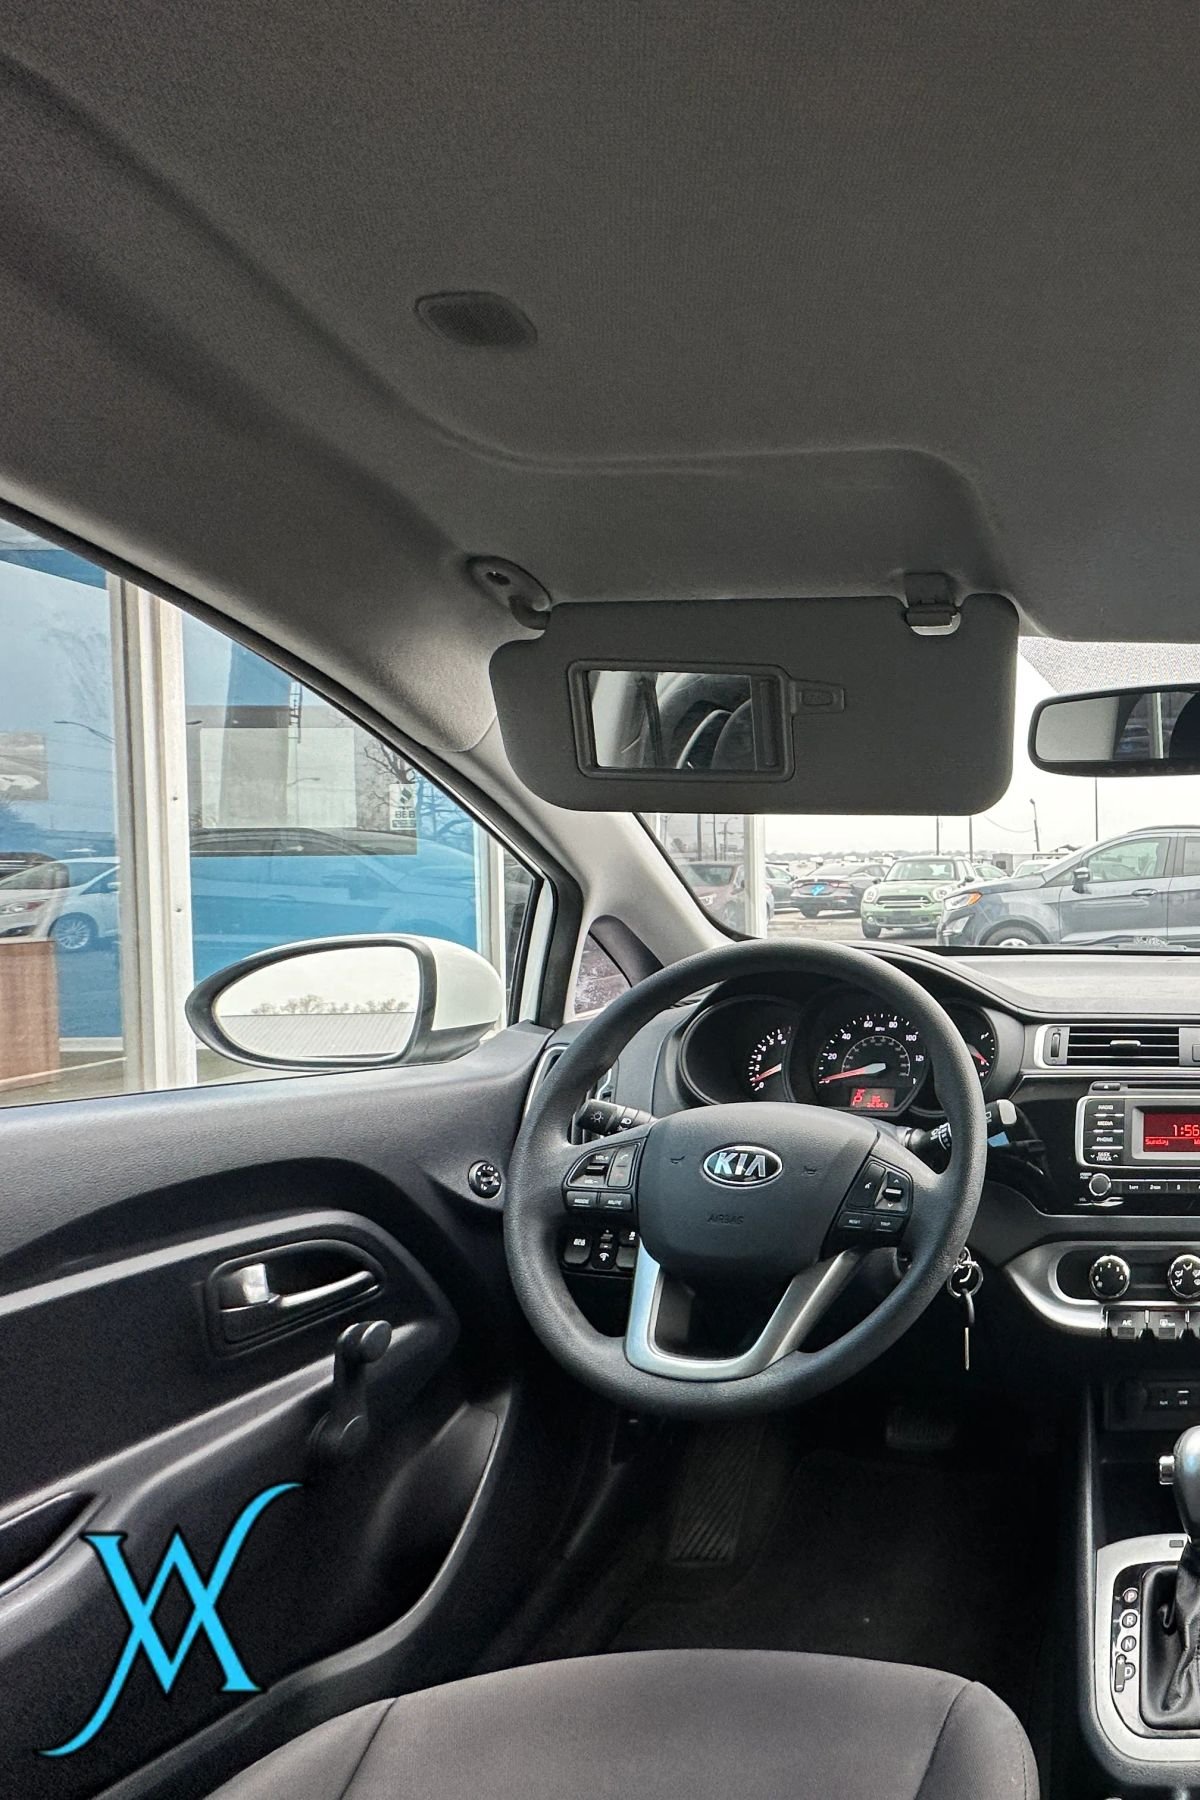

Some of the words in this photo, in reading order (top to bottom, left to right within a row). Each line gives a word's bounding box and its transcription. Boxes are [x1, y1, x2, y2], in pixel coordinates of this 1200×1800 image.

[863, 1020, 873, 1028] 60
[1173, 1124, 1200, 1137] 1:56
[1145, 1138, 1169, 1146] Sunday
[714, 1152, 766, 1177] KIA
